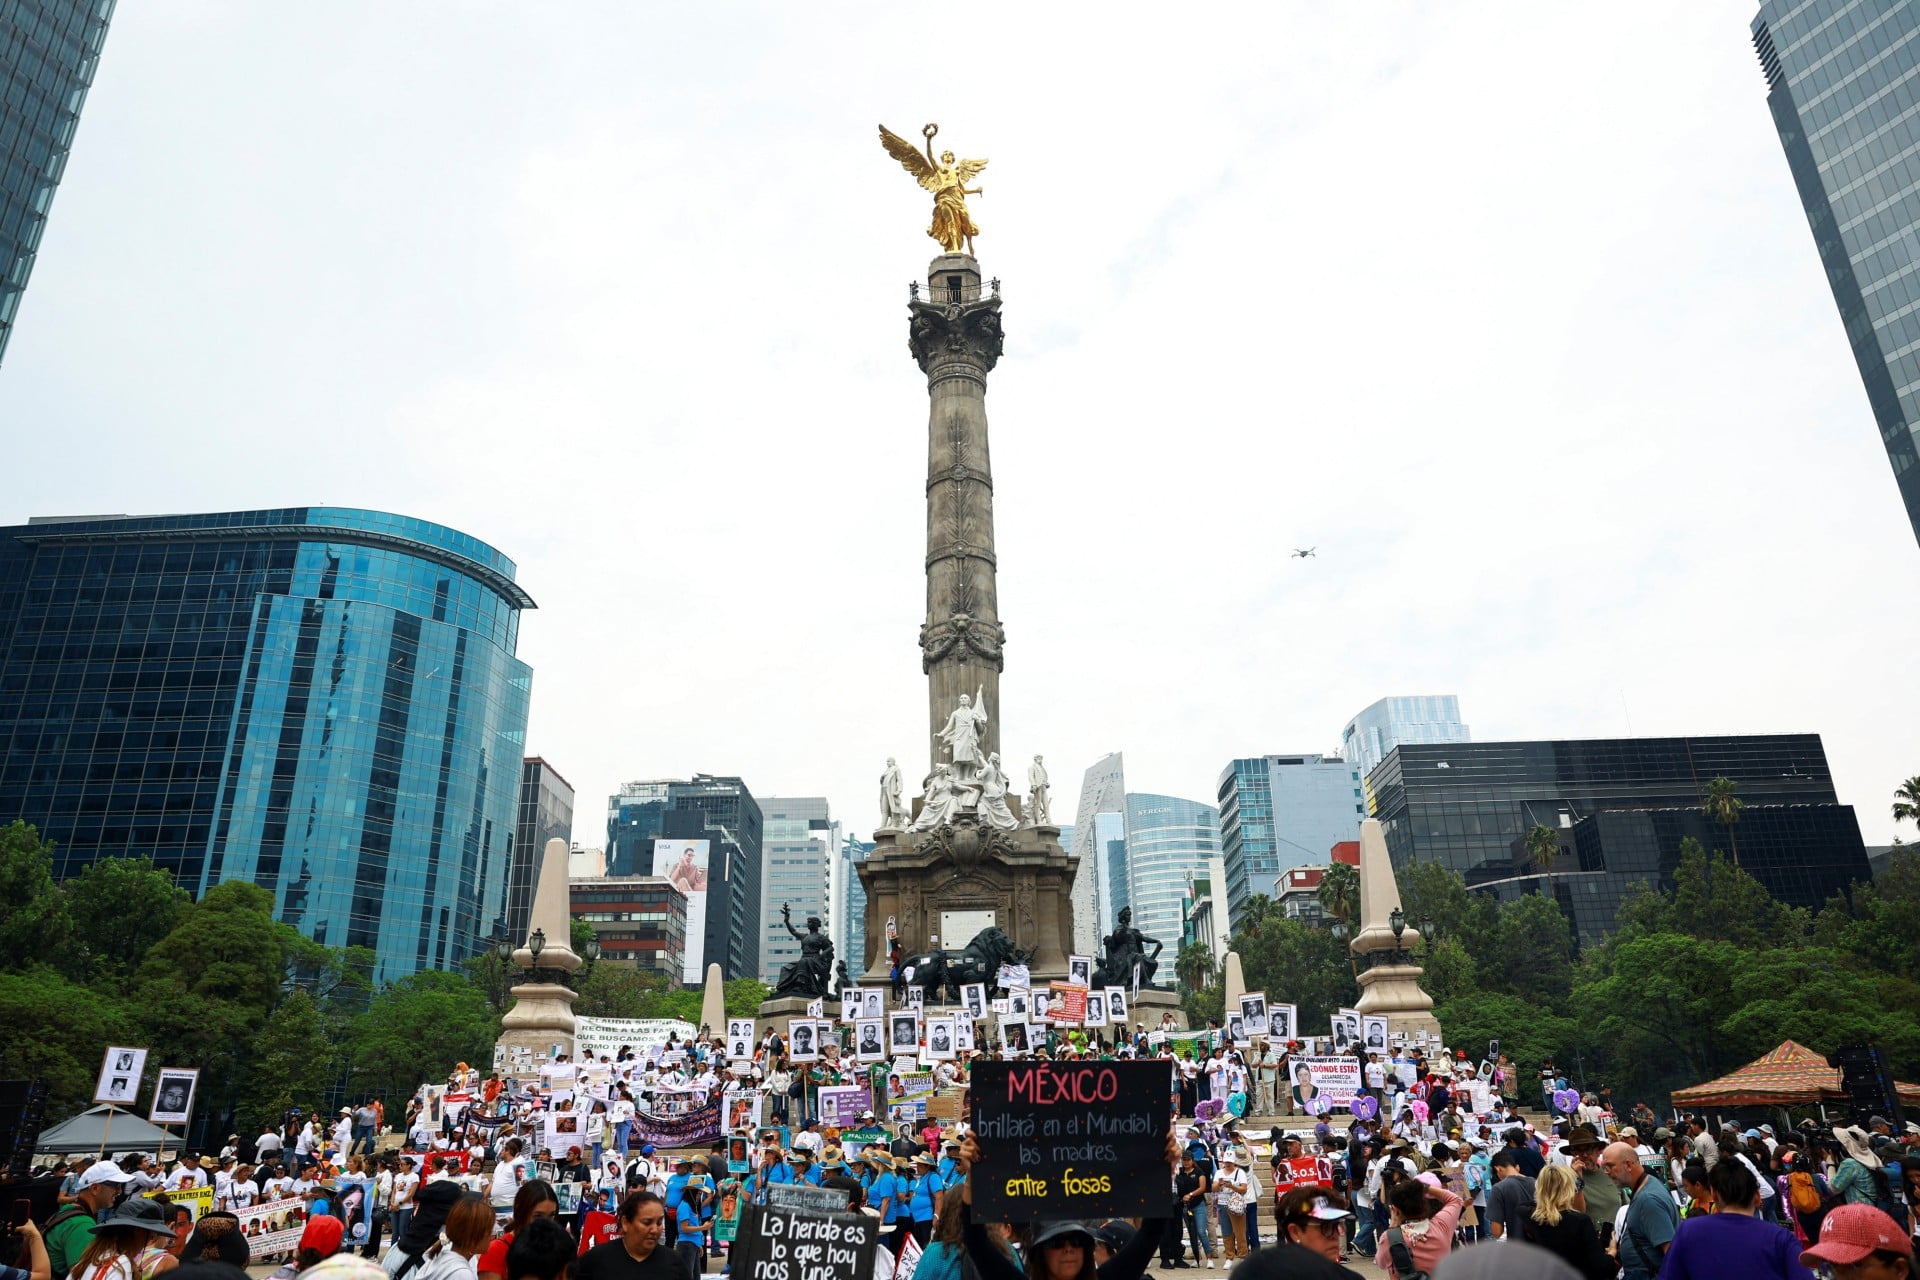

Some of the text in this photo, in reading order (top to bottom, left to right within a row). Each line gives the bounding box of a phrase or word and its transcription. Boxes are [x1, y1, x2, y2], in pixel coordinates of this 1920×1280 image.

[581, 1025, 619, 1033] RECIBE
[1008, 1063, 1118, 1104] MÉXICO
[978, 1108, 1035, 1139] brillará
[1043, 1118, 1060, 1137] en
[1066, 1115, 1079, 1135] el
[1019, 1143, 1041, 1165] las
[1005, 1168, 1112, 1197] entre fosas
[1292, 1167, 1318, 1179] S.O.S.
[761, 1212, 866, 1244] La herida es
[754, 1260, 789, 1280] nos
[771, 1238, 857, 1275] lo que hoy
